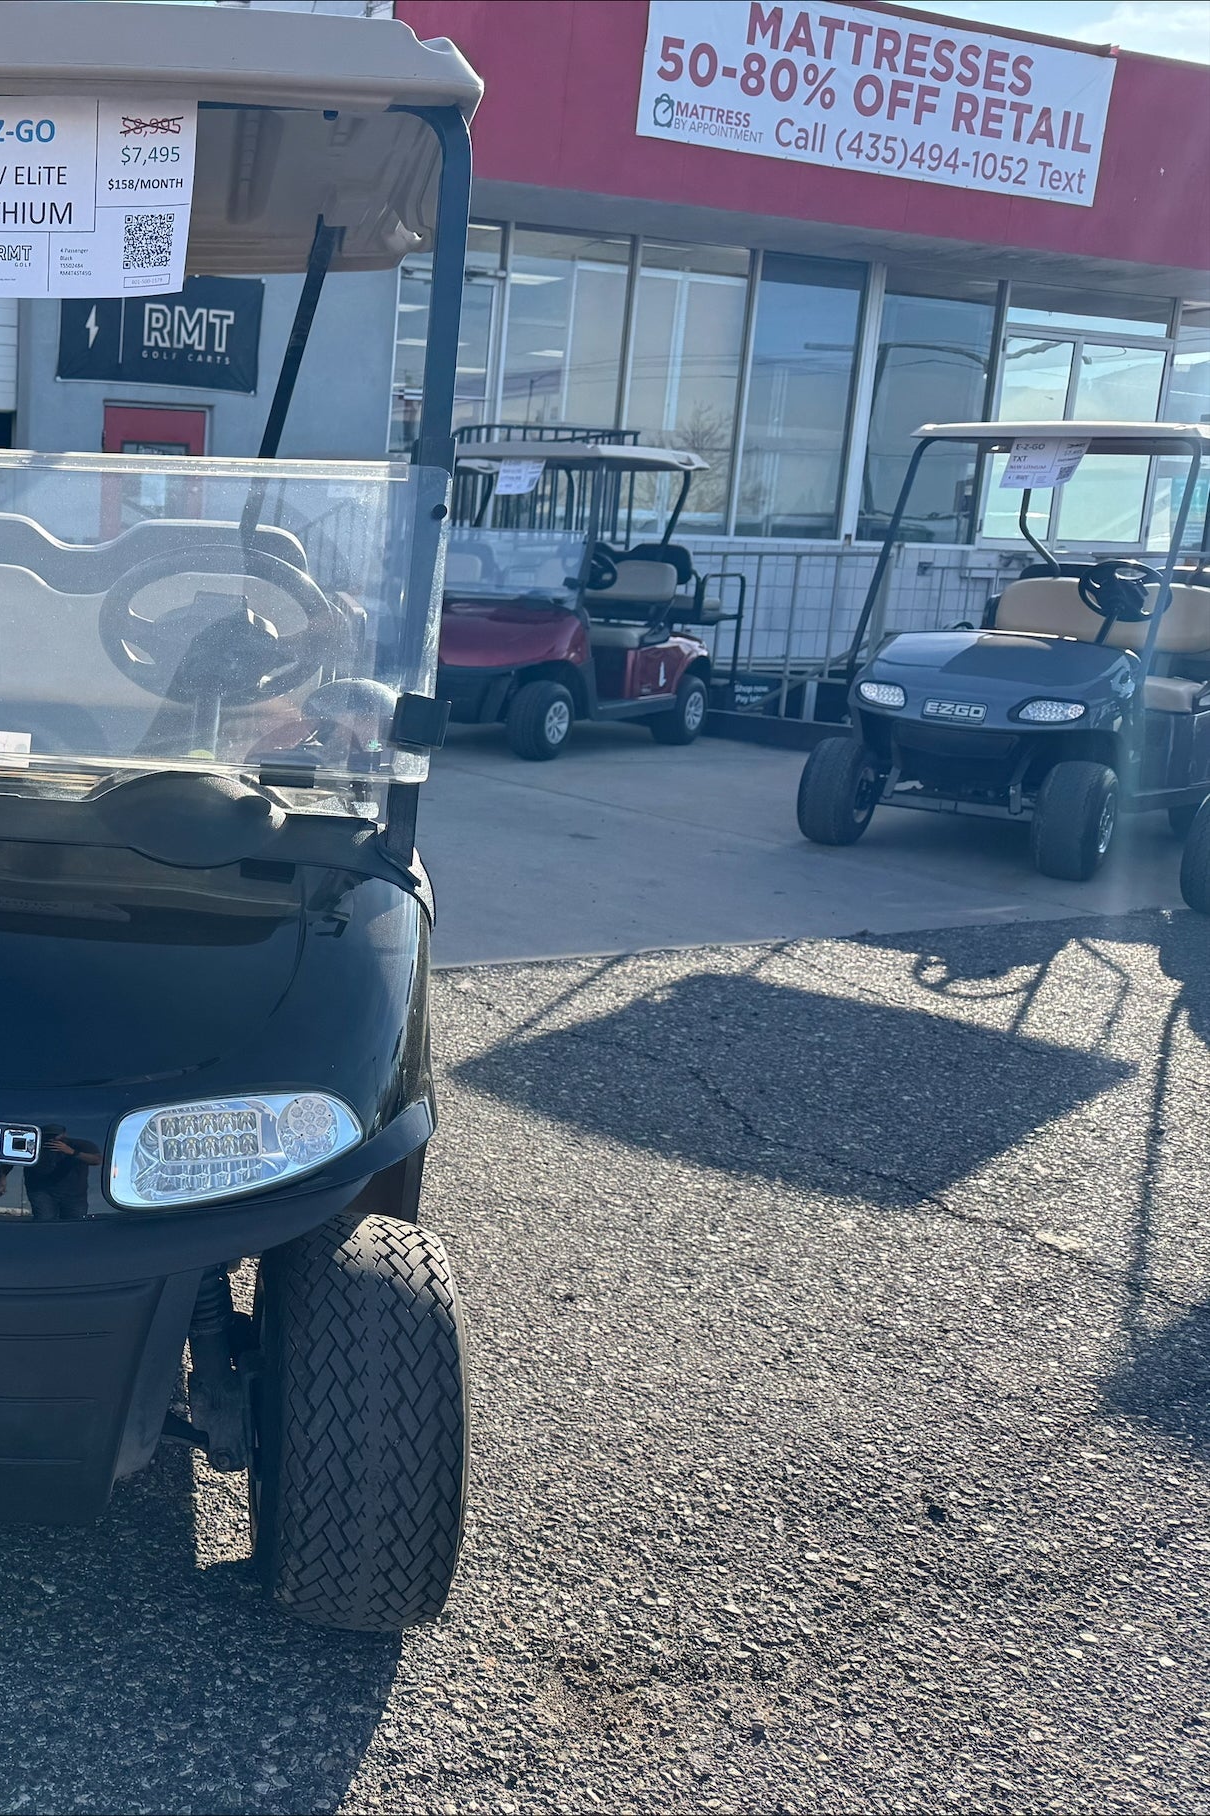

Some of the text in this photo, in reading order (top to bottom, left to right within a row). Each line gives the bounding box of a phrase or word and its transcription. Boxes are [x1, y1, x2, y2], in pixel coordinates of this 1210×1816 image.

[746, 1, 1034, 97] MATTRESSES
[657, 36, 1092, 154] 50-80% OFF RETAIL
[676, 101, 751, 128] MATTRESS
[674, 118, 764, 144] BY APPOINTMENT
[121, 145, 180, 166] $7,495
[775, 118, 1087, 194] Call (435)494-1052 Text
[15, 166, 67, 185] ELiTE
[108, 178, 183, 191] $158/MONTH
[143, 303, 234, 353] RMT
[142, 350, 231, 365] GOLF CARTS
